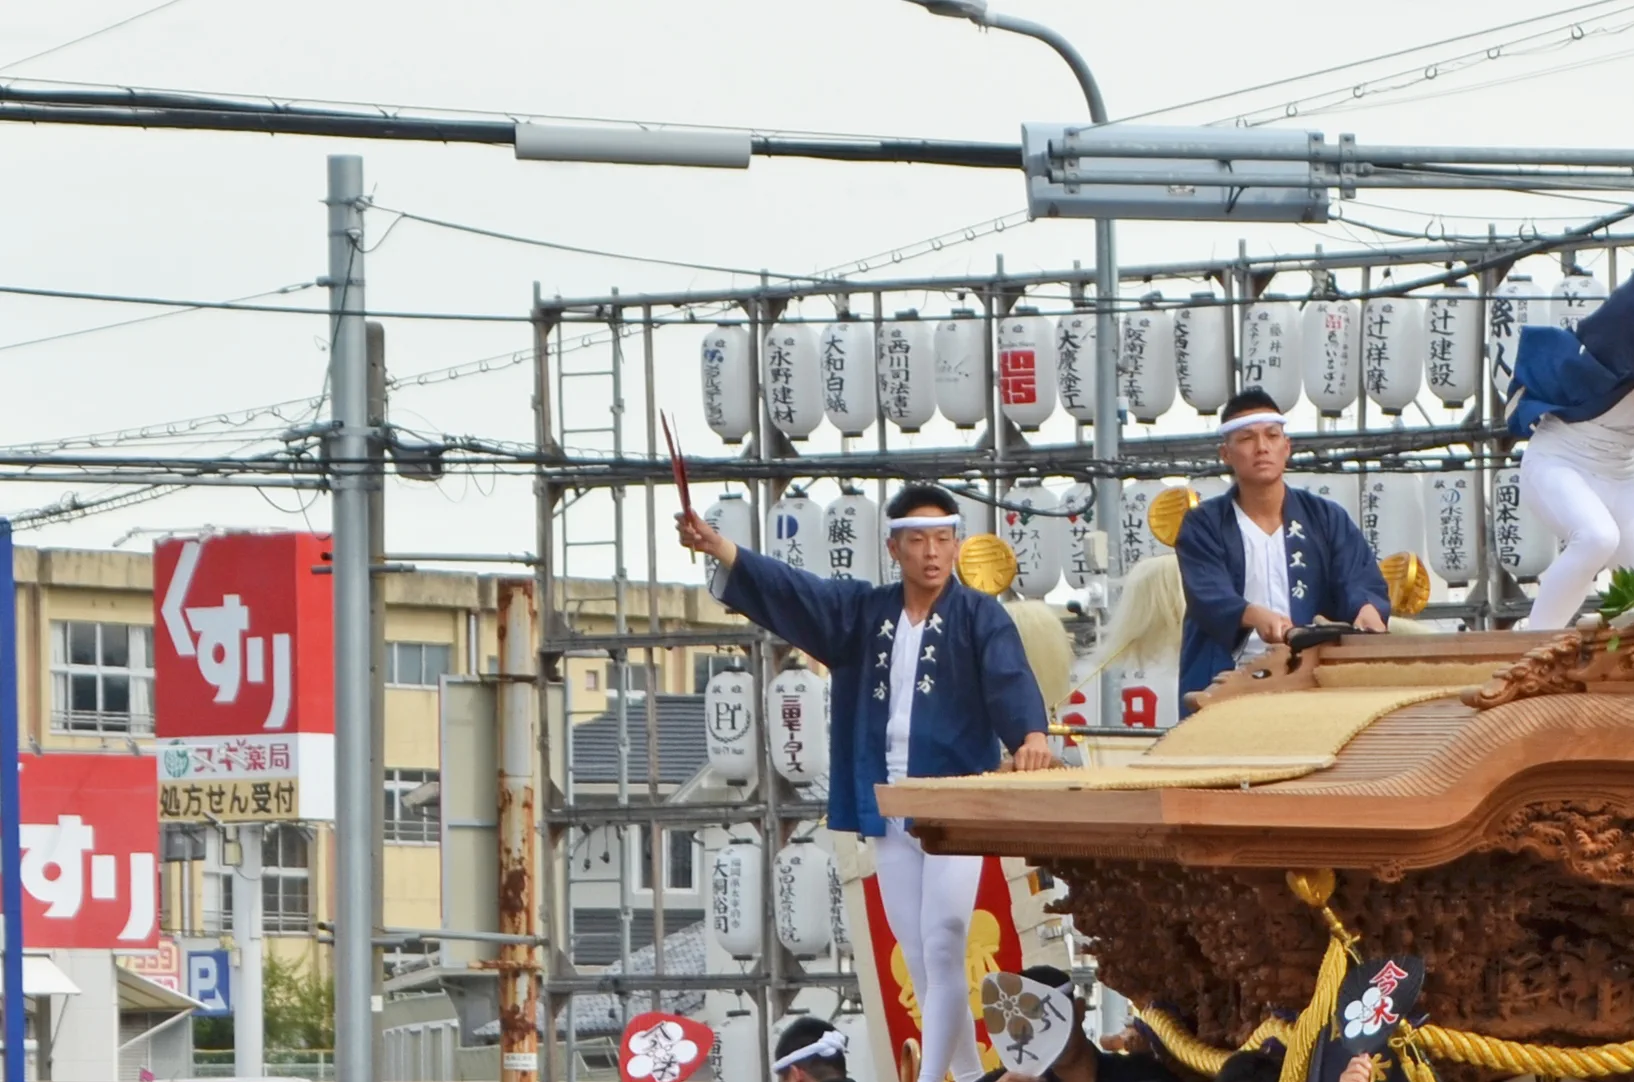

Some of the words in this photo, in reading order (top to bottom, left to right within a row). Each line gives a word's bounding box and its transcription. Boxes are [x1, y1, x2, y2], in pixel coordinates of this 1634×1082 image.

[1496, 484, 1522, 567] 岡本薬局
[161, 541, 291, 730] くすり
[916, 612, 944, 696] 大工方
[159, 782, 295, 816] 処方せん受付
[18, 813, 156, 942] すり
[1361, 959, 1409, 1026] 今木
